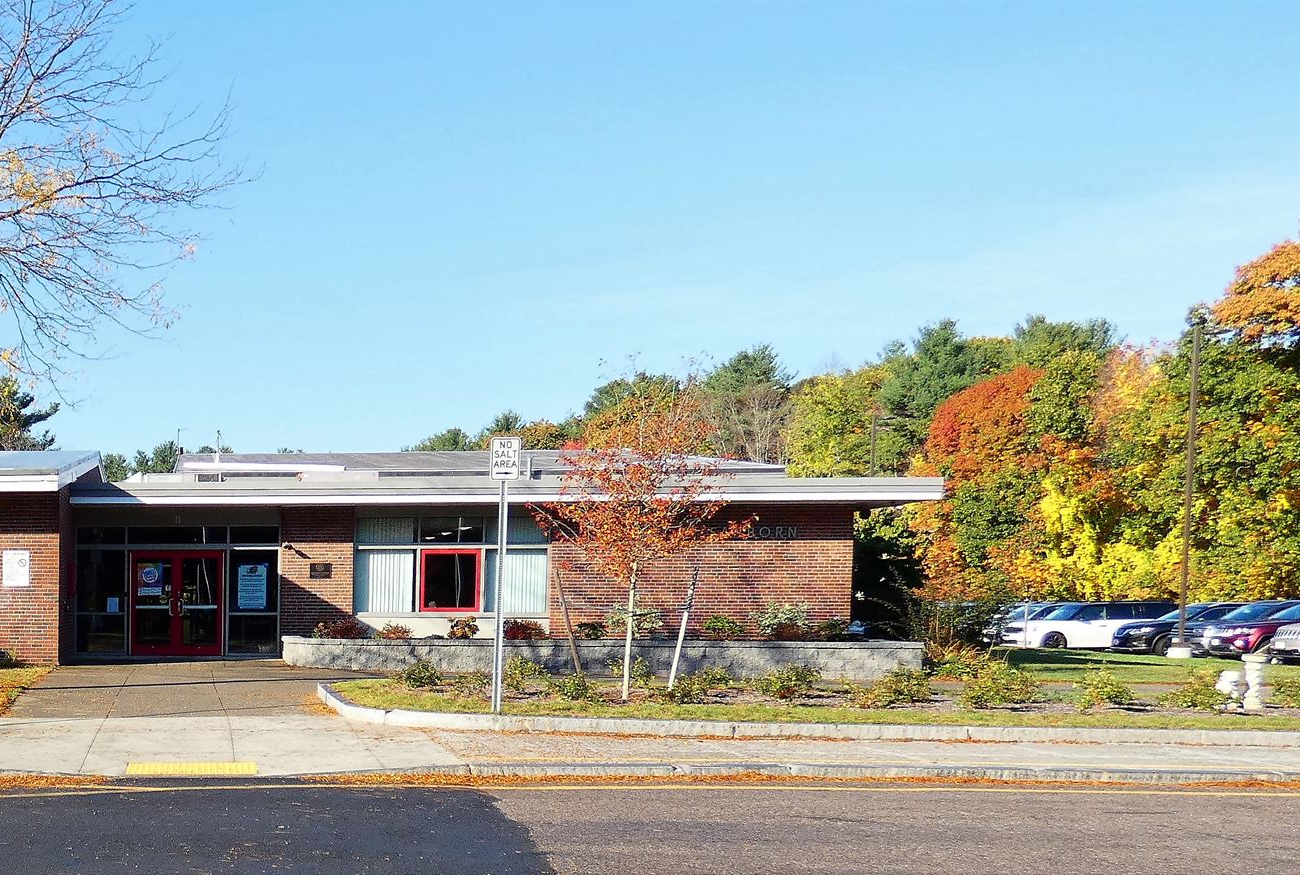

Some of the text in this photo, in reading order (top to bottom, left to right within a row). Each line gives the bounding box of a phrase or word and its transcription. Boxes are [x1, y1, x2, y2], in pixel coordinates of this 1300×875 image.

[500, 441, 512, 449] NO
[494, 450, 517, 458] SALT
[493, 460, 517, 468] AREA
